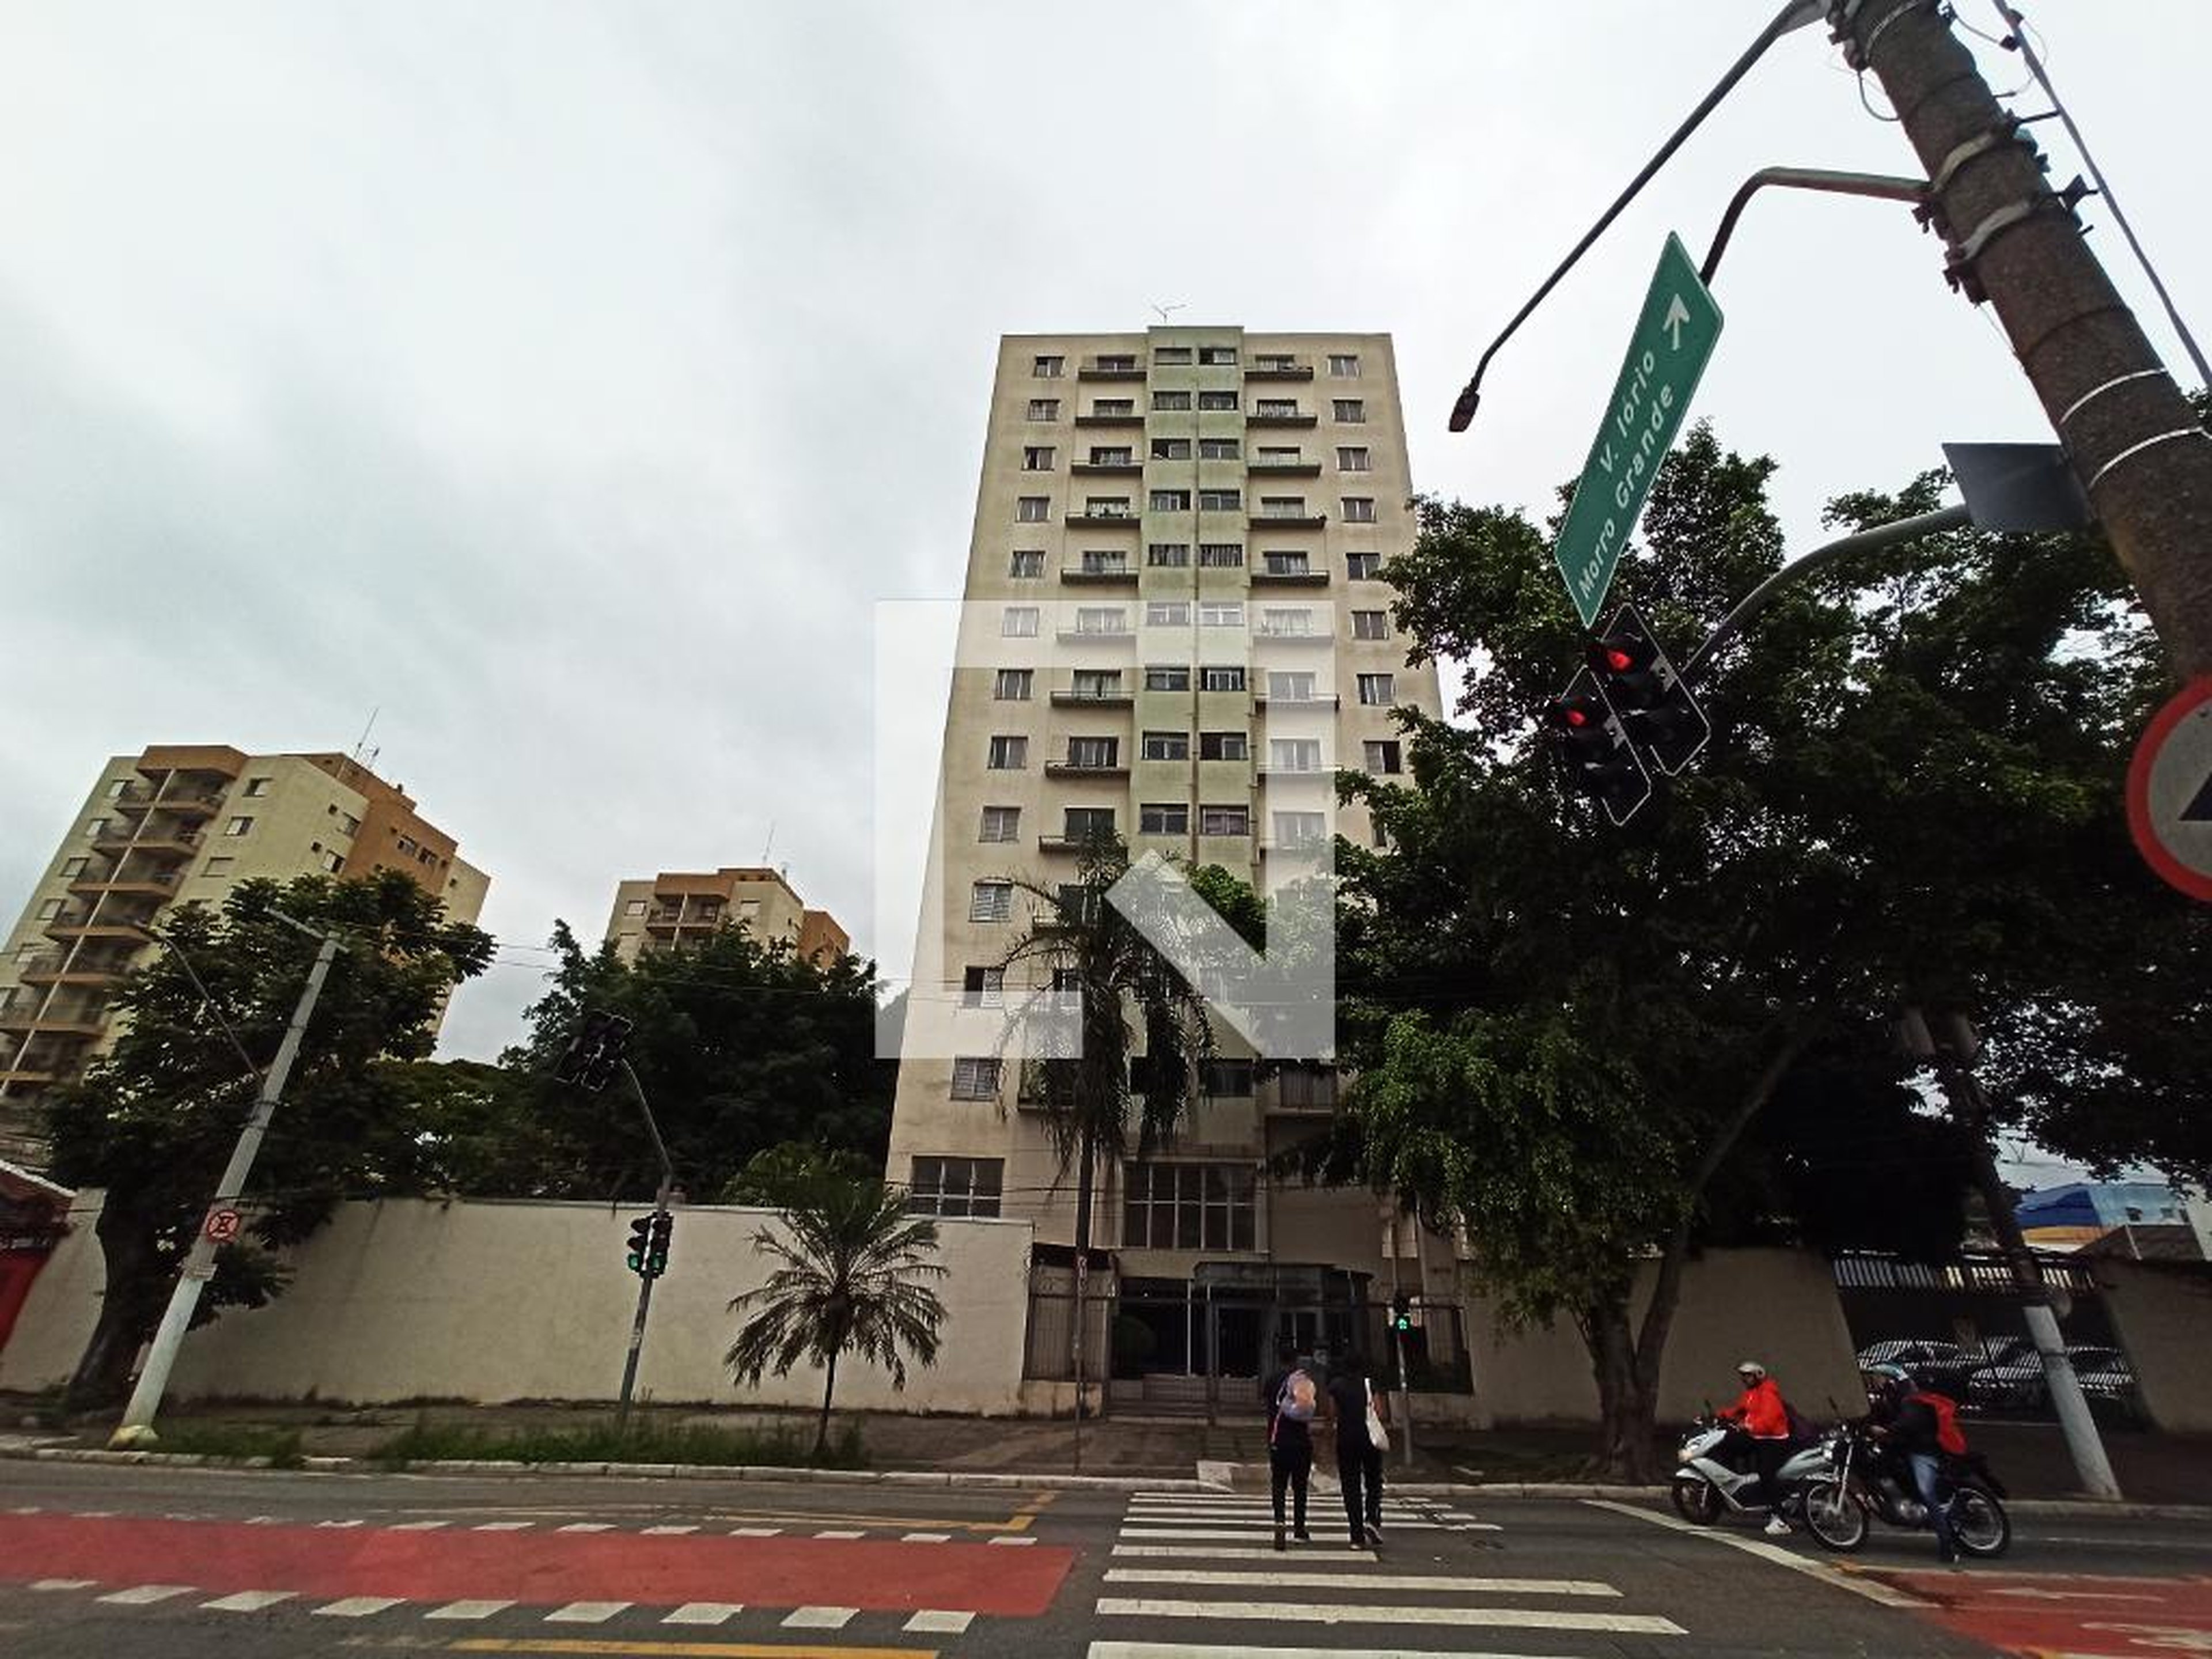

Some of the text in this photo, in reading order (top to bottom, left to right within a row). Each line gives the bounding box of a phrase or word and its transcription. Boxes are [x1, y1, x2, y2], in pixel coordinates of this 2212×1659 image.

[1578, 384, 1673, 600] Morro Grande
[1600, 442, 1619, 473] V.
